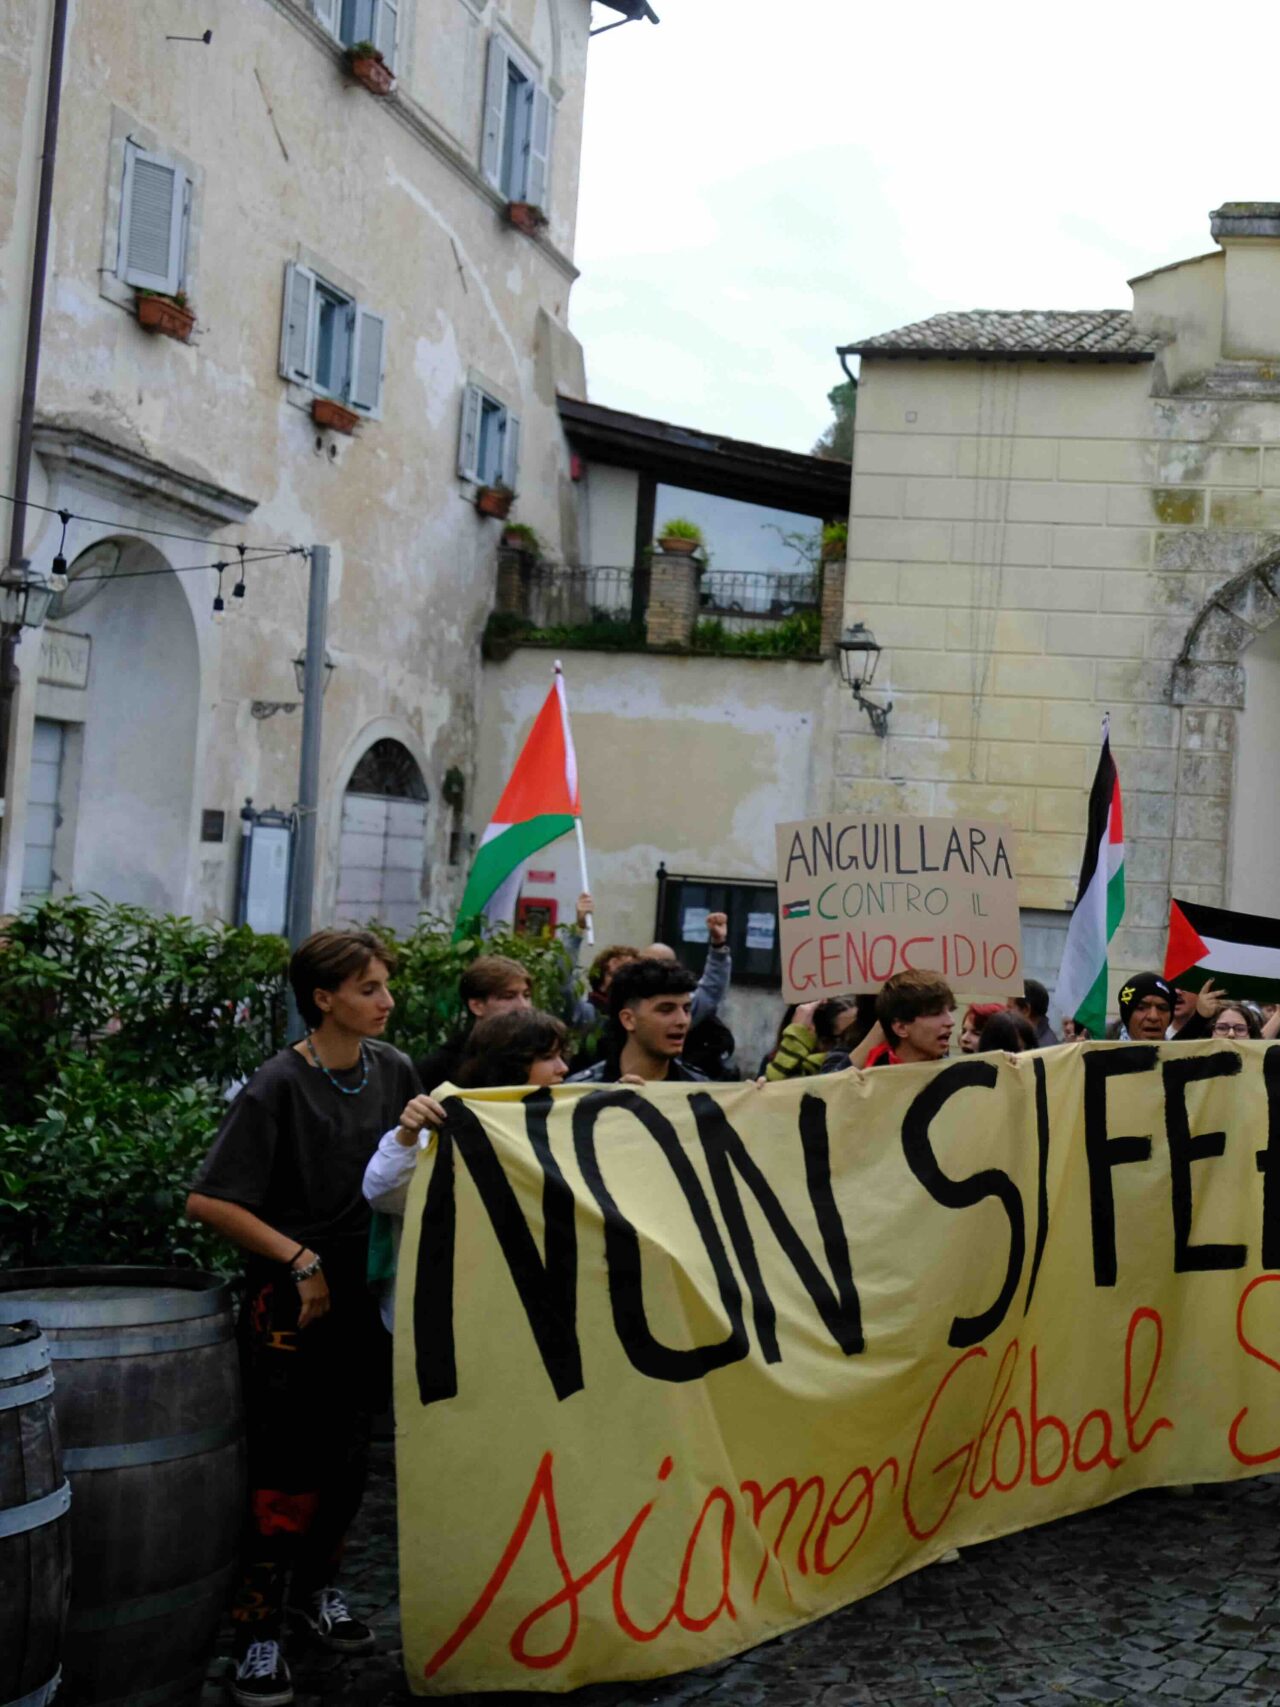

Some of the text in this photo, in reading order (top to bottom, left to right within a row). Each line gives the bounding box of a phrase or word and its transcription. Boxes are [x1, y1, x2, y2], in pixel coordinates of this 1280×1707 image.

[785, 822, 1013, 882] ANGUILLARA
[817, 882, 989, 920] CONTRO IL
[788, 931, 1018, 991] GENOCIDIO
[413, 1086, 867, 1406] NON
[900, 1056, 1049, 1350] SI
[901, 1307, 1174, 1541] Global
